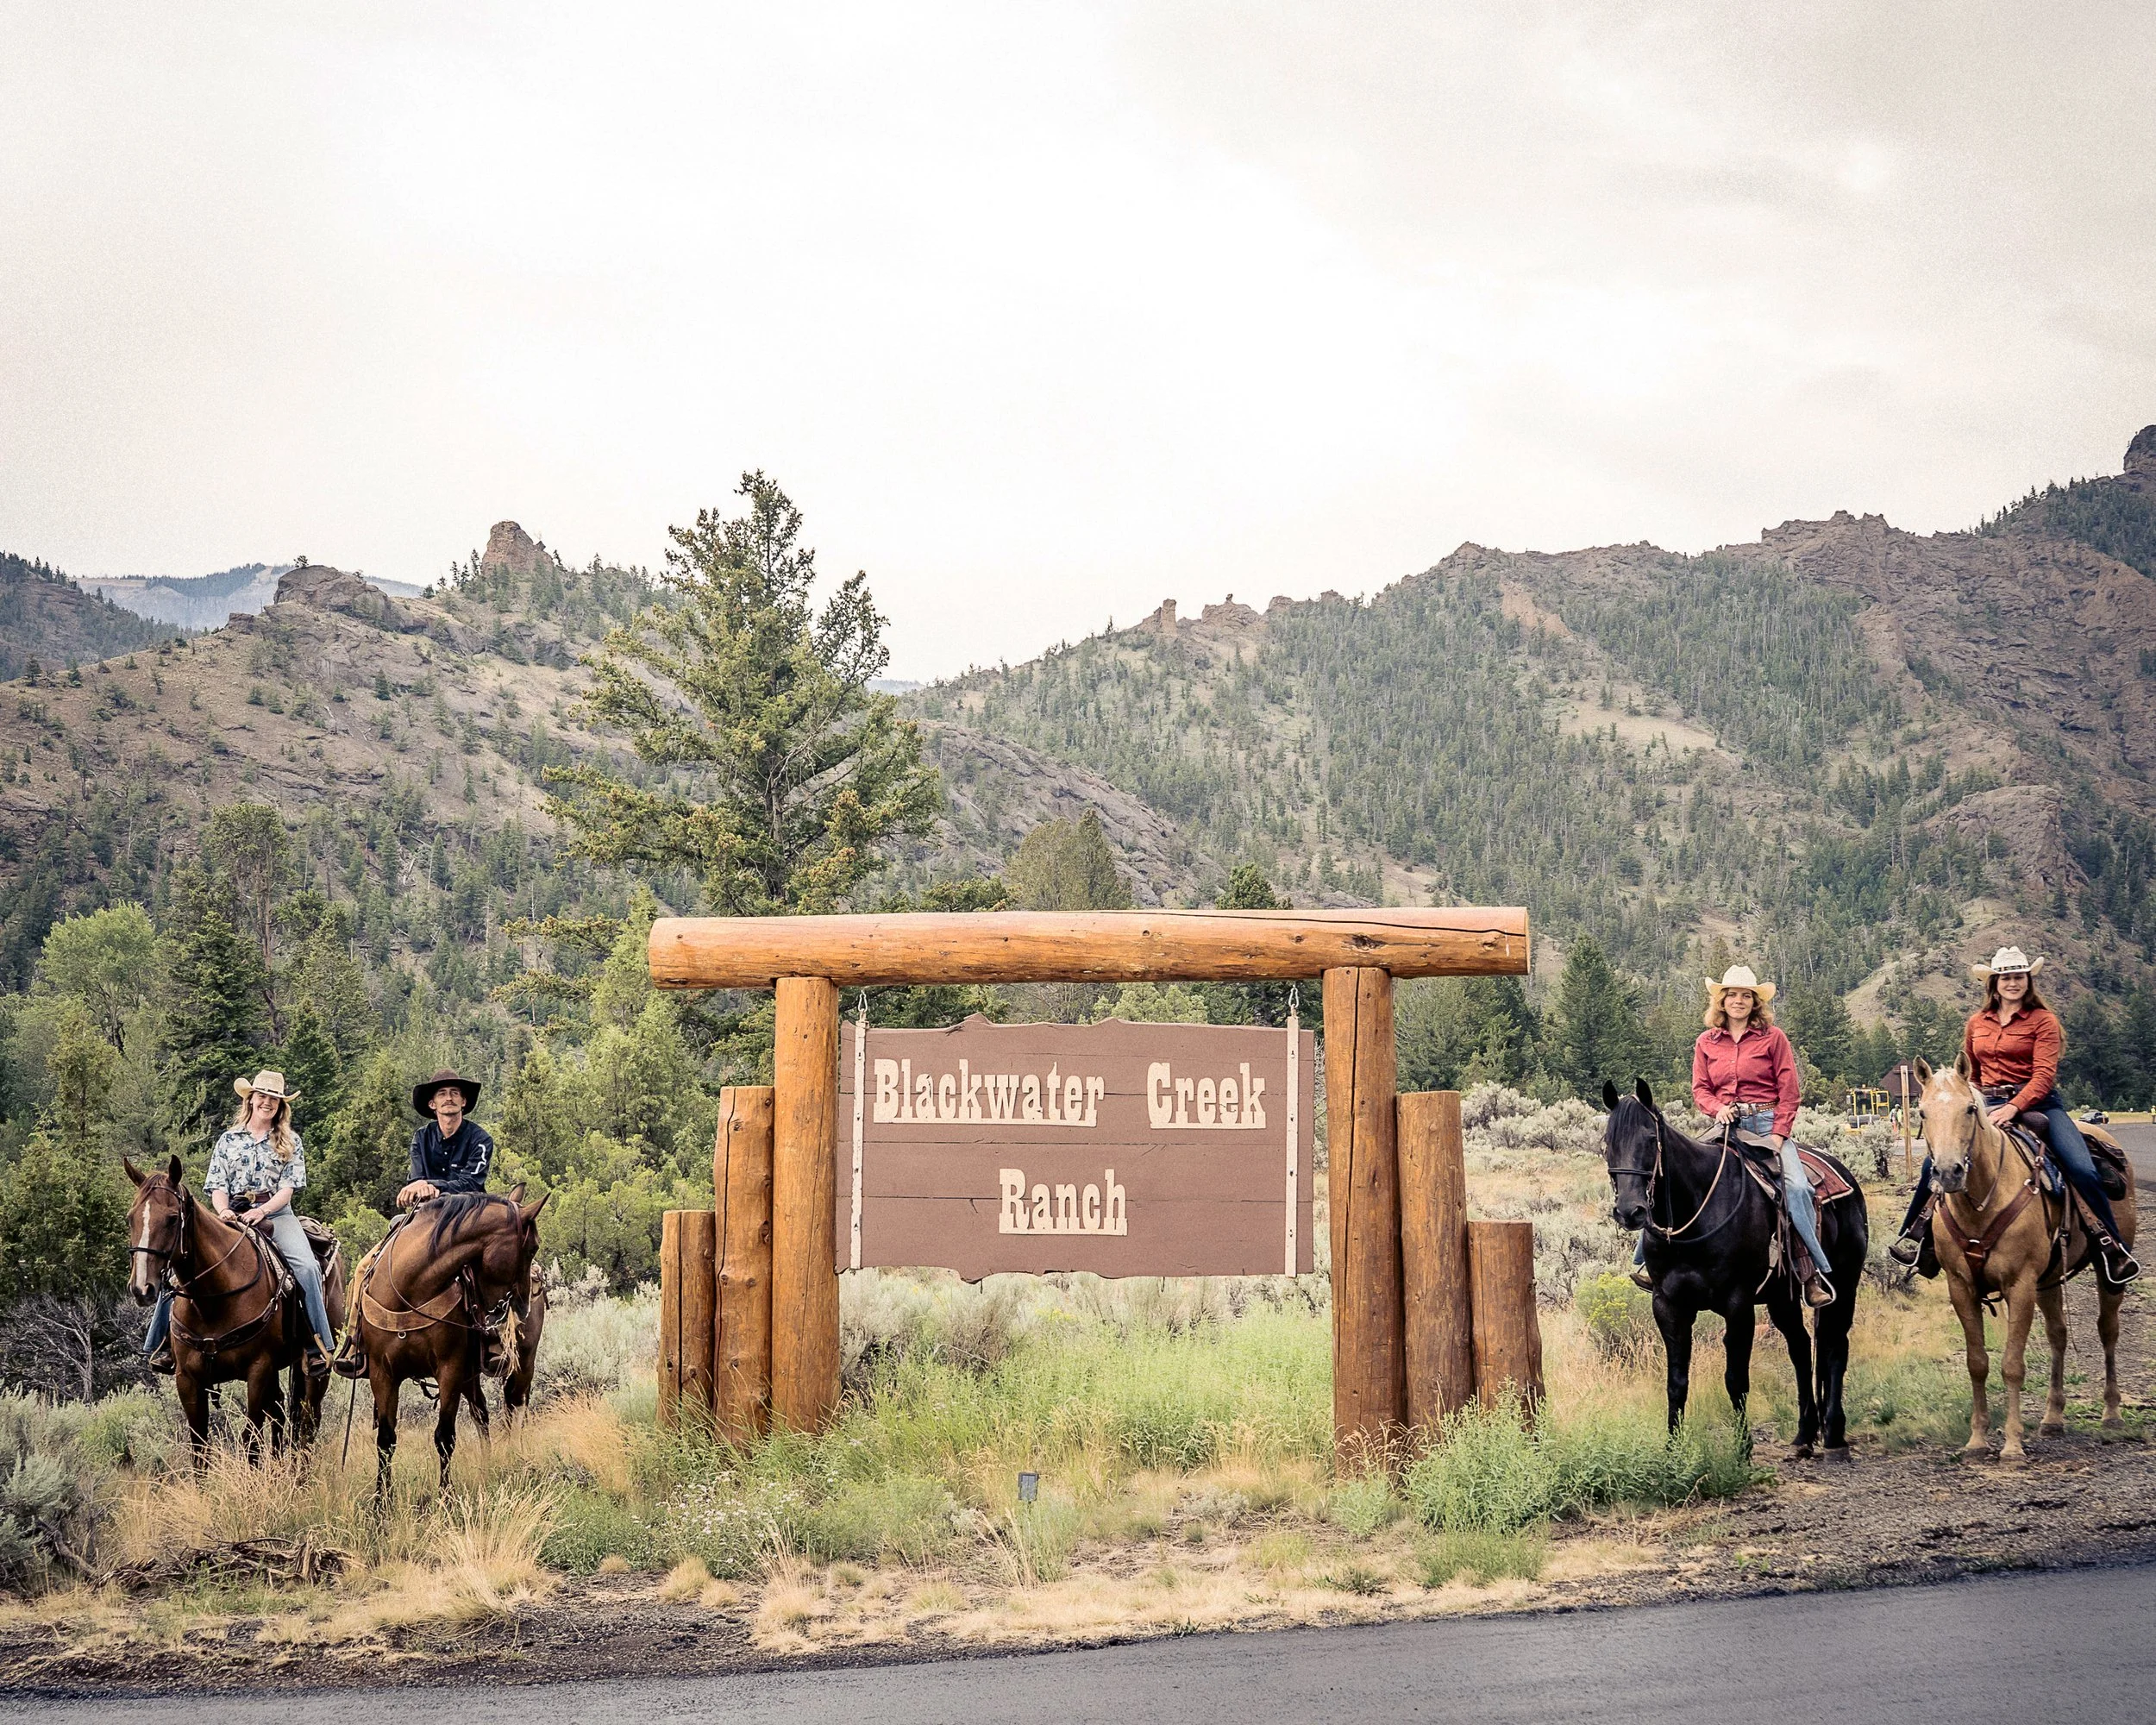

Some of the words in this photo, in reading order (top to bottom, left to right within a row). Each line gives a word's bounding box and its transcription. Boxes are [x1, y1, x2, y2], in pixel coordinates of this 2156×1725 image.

[874, 1058, 1105, 1127] Blackwater
[1147, 1062, 1266, 1130] Creek
[999, 1168, 1128, 1235] Ranch
